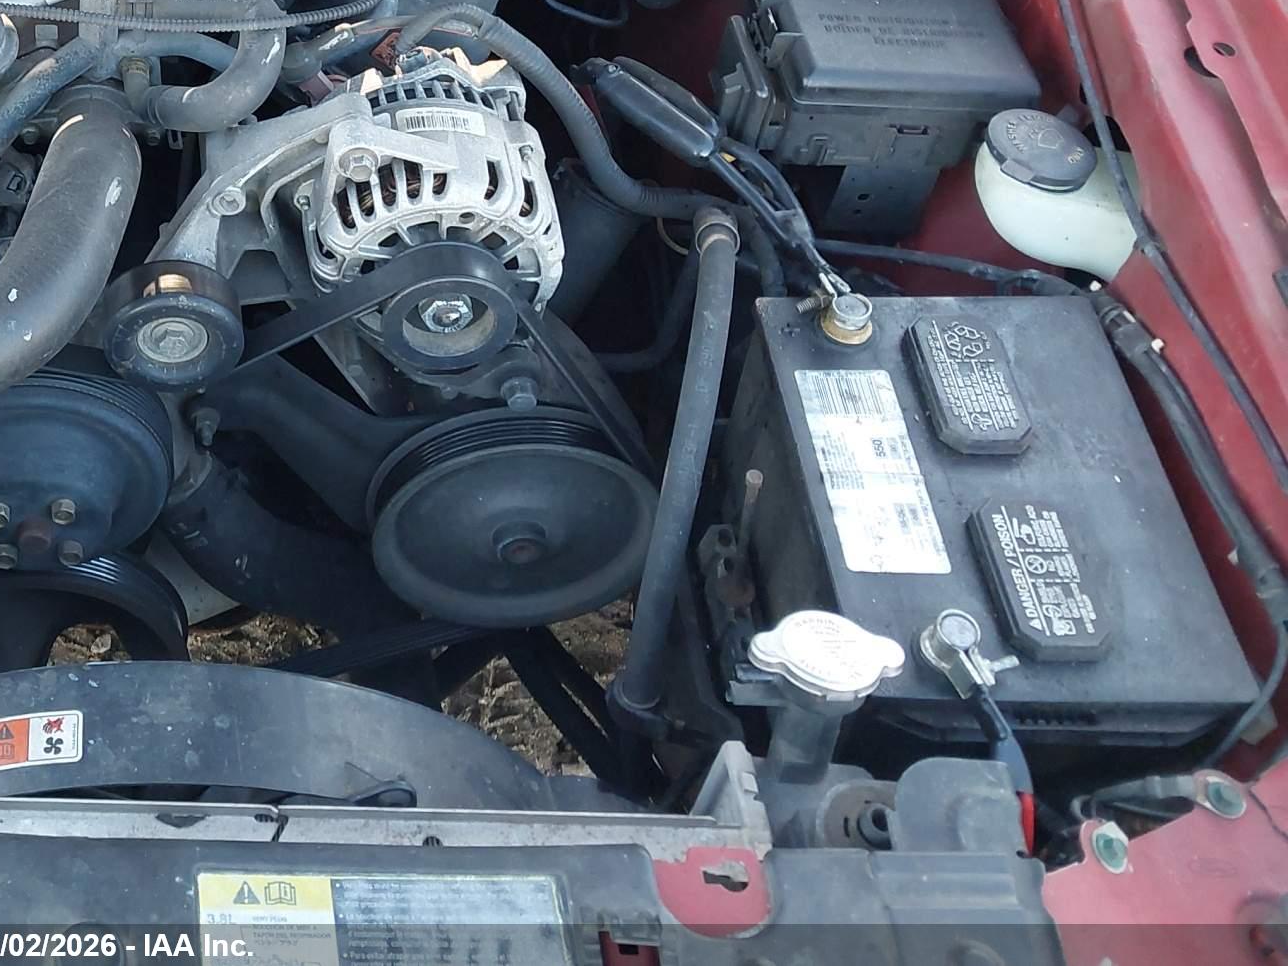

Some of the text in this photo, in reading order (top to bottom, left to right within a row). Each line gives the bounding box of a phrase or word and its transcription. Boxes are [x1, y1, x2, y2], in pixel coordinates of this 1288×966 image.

[873, 439, 887, 458] 550
[991, 513, 1016, 556] POISON
[1013, 569, 1037, 617] DANGER
